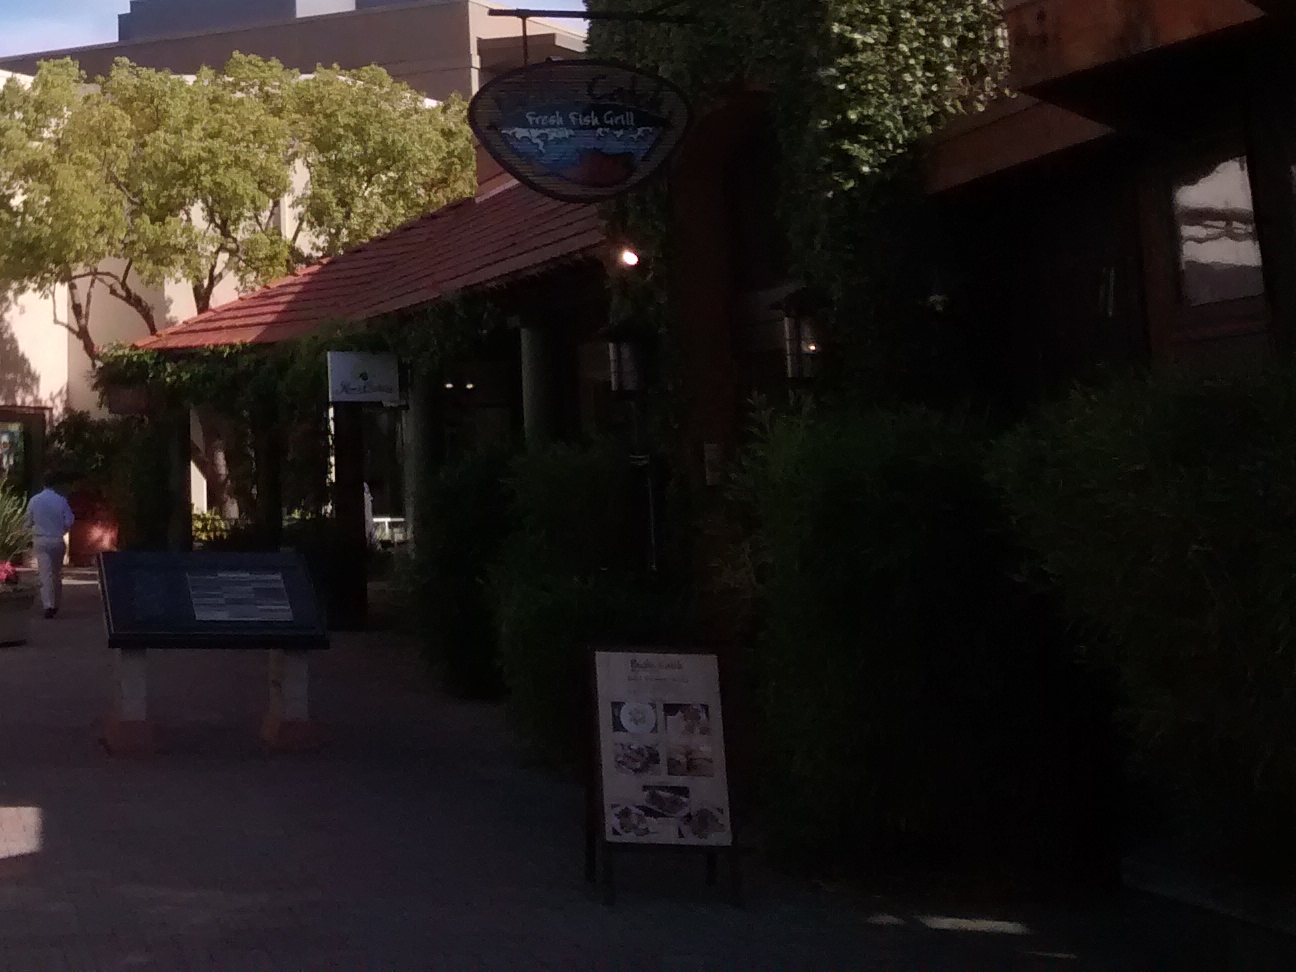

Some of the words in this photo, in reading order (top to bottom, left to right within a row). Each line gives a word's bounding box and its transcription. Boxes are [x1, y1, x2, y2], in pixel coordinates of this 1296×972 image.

[525, 110, 564, 126] Fresh
[568, 110, 600, 126] Fish
[603, 110, 635, 126] Grill
